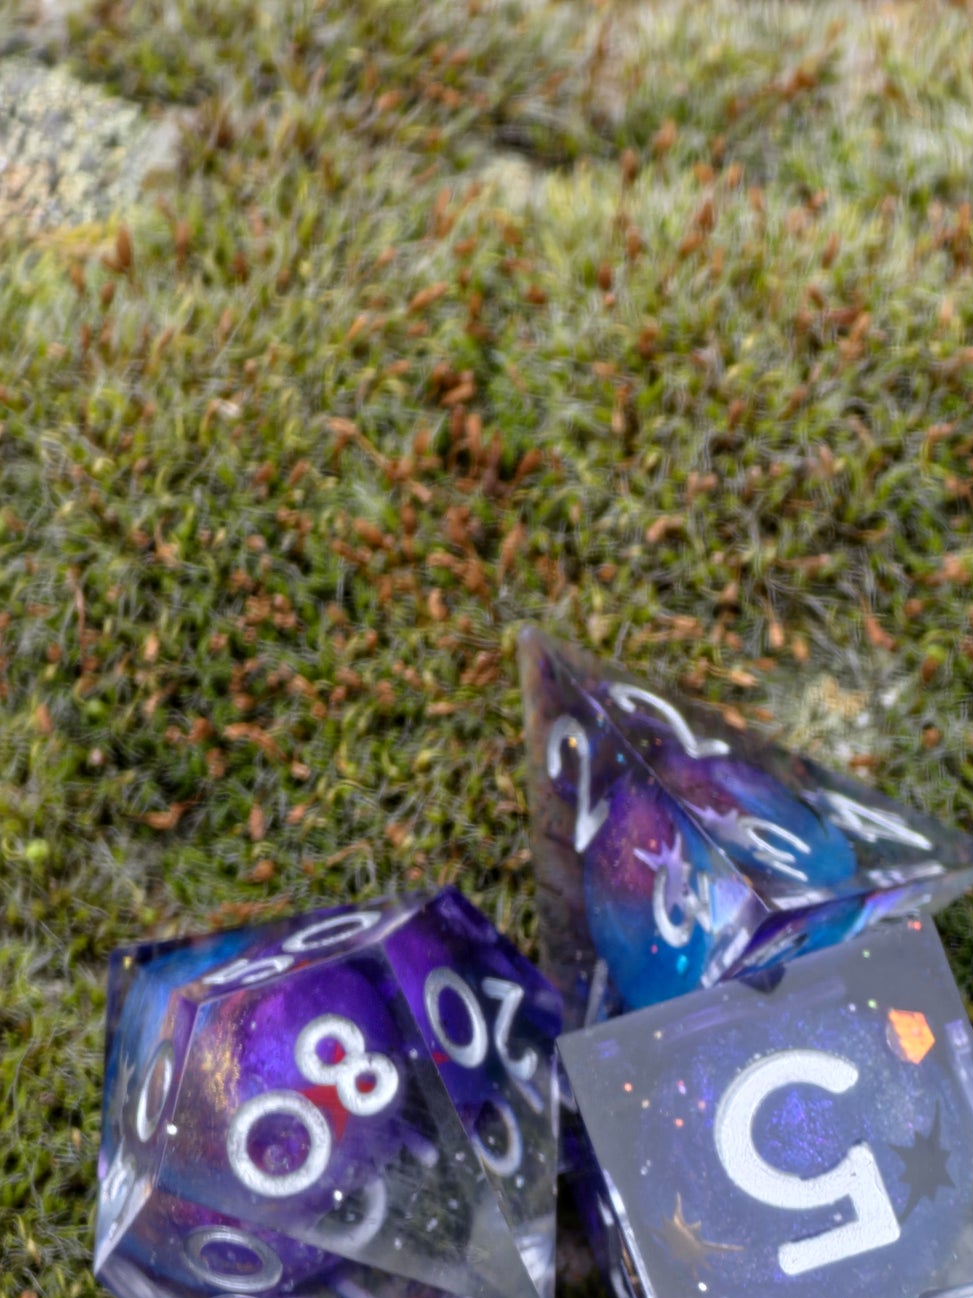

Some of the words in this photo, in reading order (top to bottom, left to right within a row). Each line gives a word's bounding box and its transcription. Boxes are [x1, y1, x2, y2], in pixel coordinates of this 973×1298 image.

[548, 716, 608, 853] 2
[608, 683, 730, 759] 2
[226, 1013, 400, 1198] 80
[714, 1049, 901, 1276] 5
